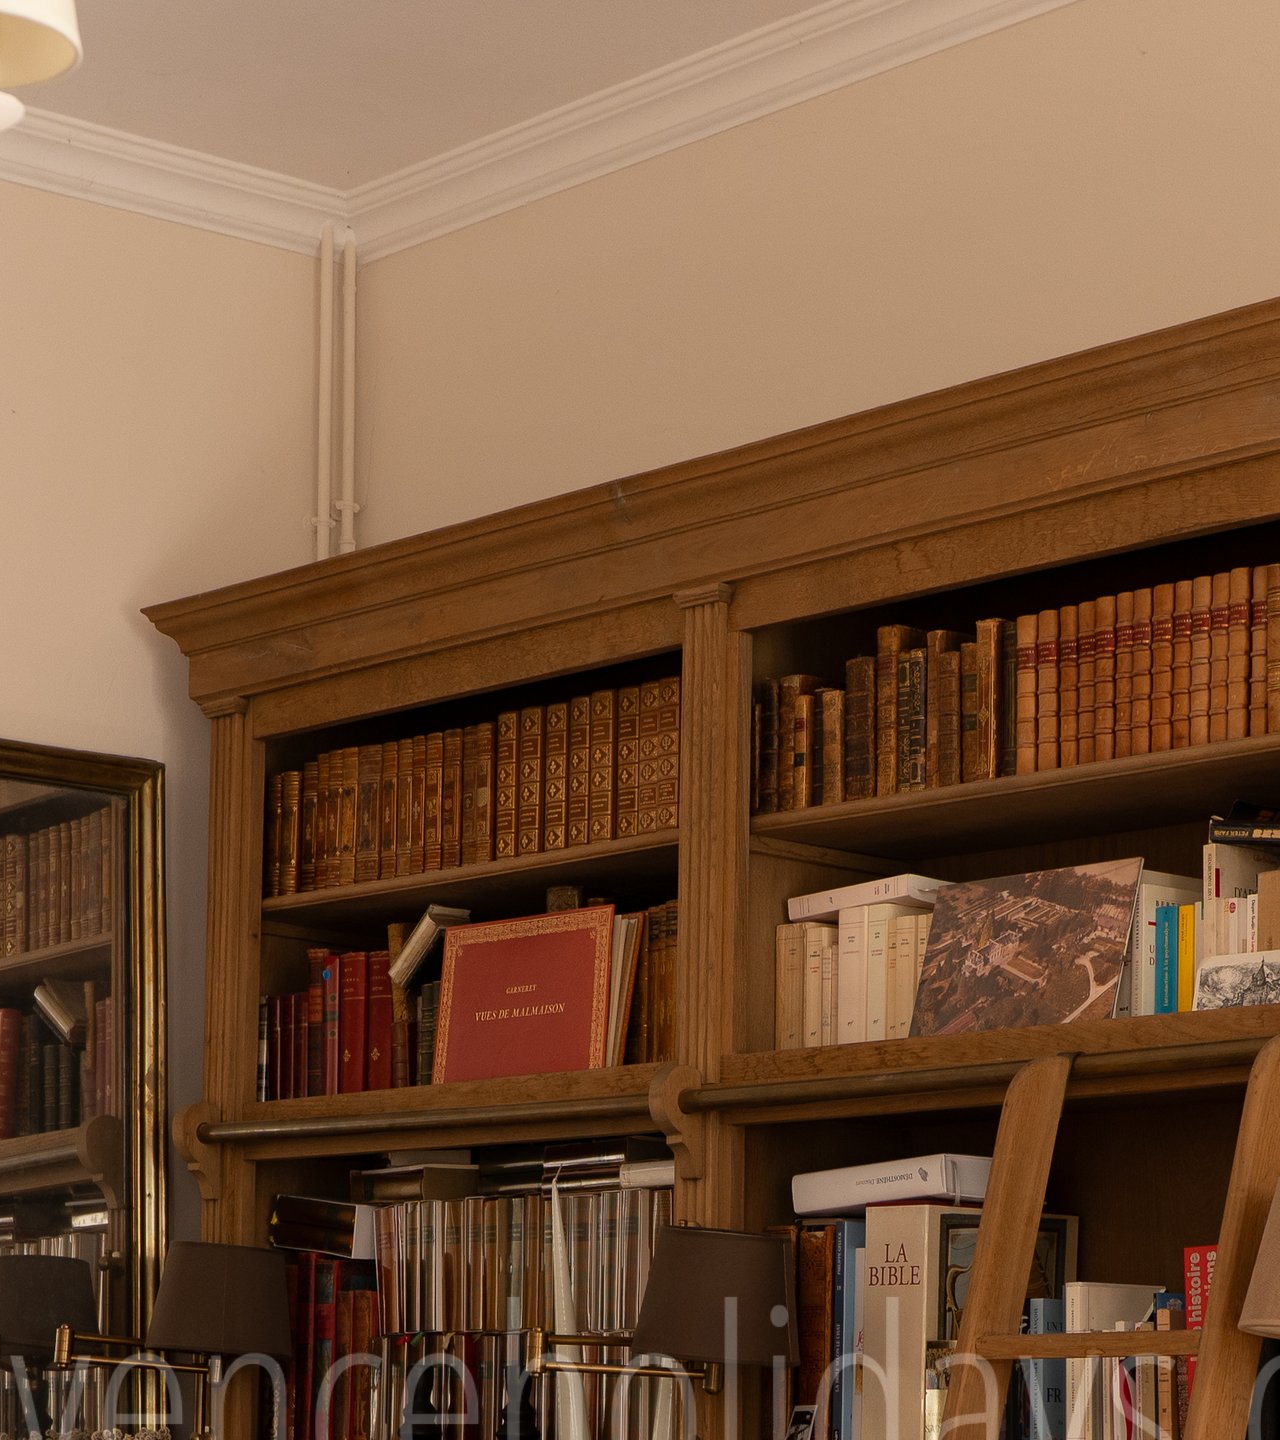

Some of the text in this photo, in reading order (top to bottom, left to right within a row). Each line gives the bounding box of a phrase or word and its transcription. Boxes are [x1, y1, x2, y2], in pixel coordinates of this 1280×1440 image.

[475, 1003, 565, 1021] VUES DE MALMAISON
[884, 1243, 908, 1263] LA
[868, 1265, 921, 1286] BIBLE
[1187, 1252, 1202, 1323] histoire
